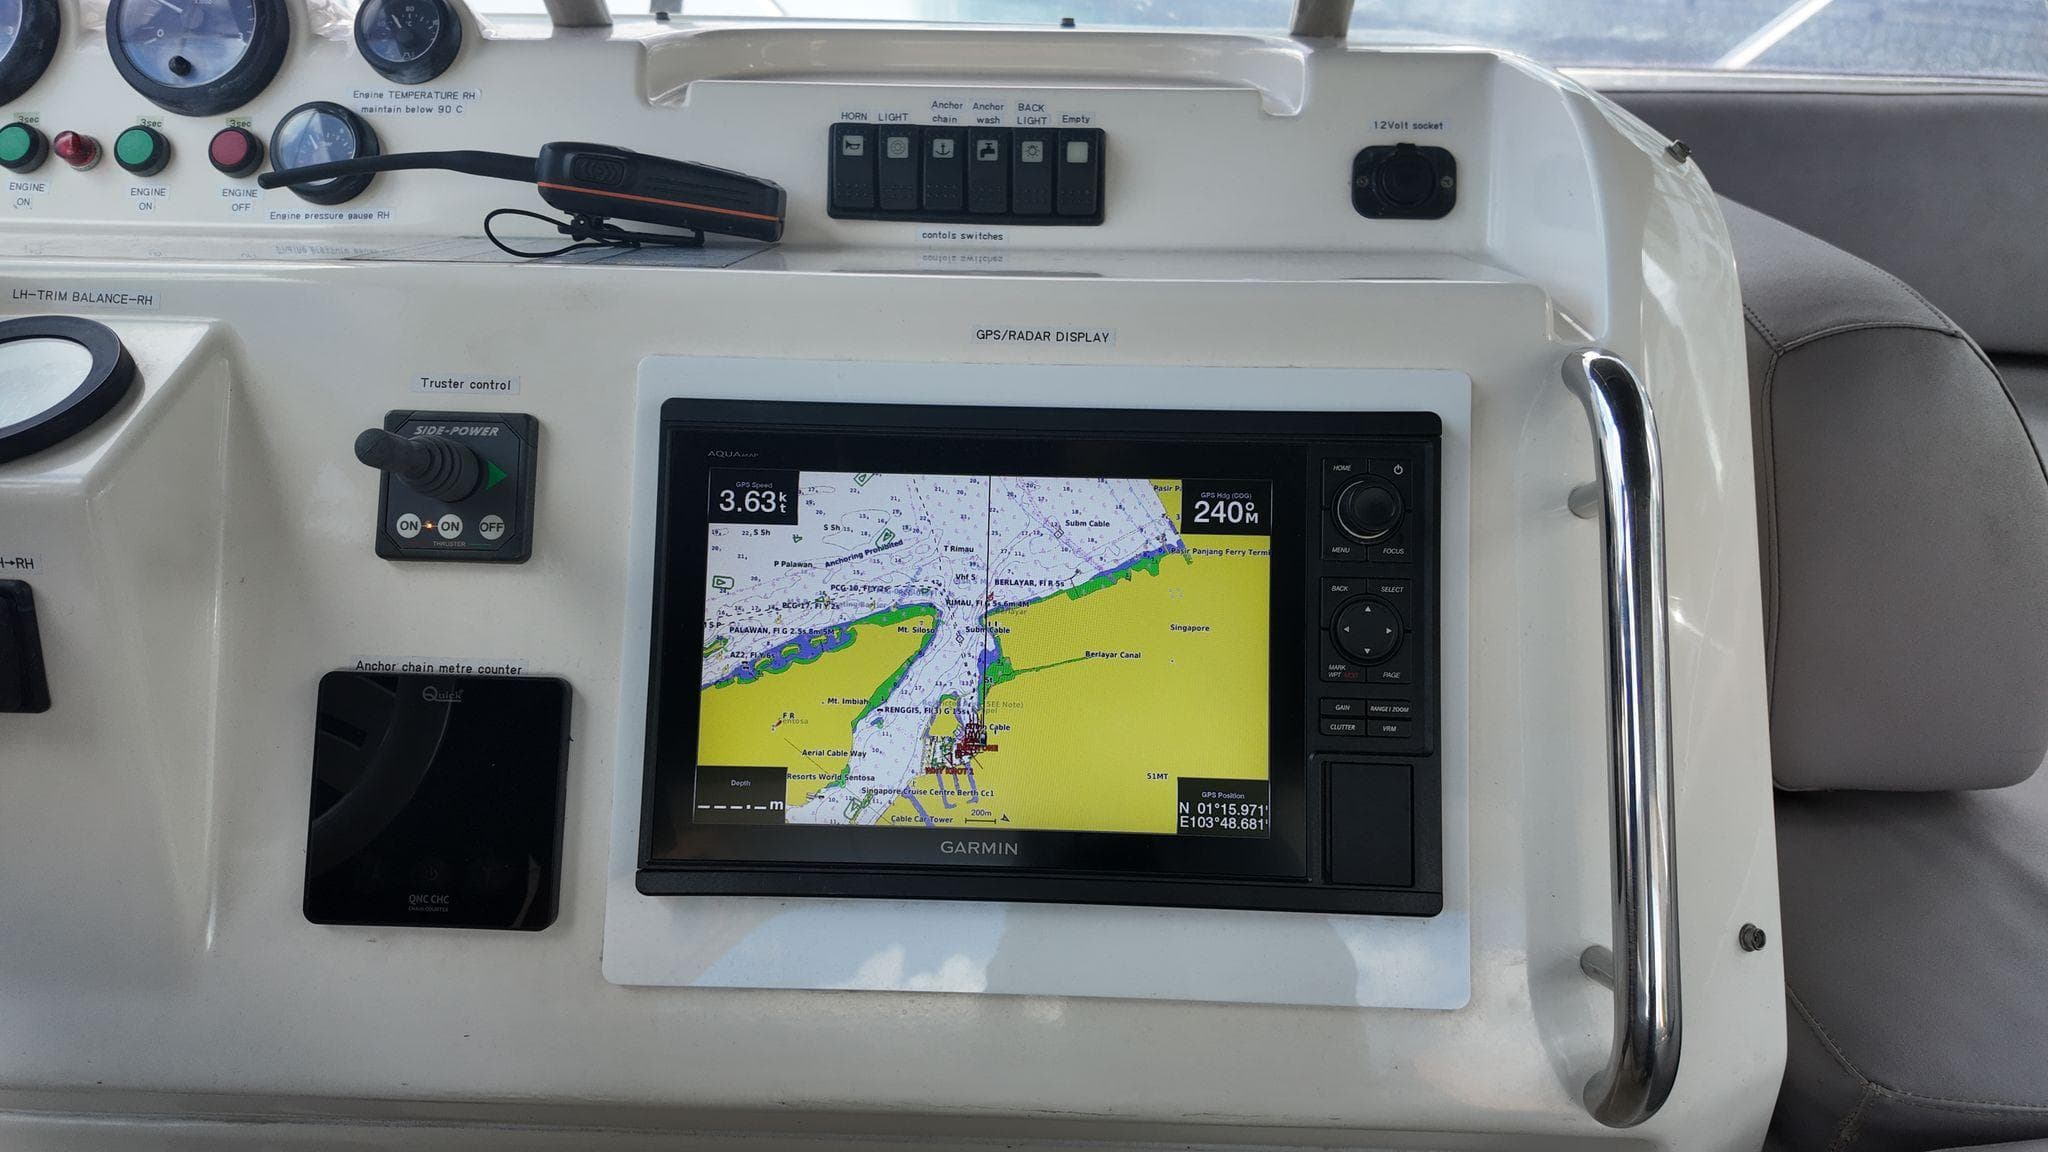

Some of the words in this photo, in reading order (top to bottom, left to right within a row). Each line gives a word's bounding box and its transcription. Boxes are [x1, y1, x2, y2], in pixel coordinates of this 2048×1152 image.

[353, 90, 383, 100] Engine
[388, 91, 459, 100] TEMPERATURE
[361, 105, 401, 113] maintain
[405, 105, 433, 114] below
[438, 105, 451, 113] 90
[931, 101, 963, 110] Anchor
[972, 103, 1004, 111] Anchor
[1018, 103, 1044, 112] BACK
[841, 112, 867, 121] HORN
[878, 113, 908, 121] LIGHT
[932, 115, 957, 123] chain
[977, 116, 1000, 124] wash
[1017, 117, 1047, 125] LIGHT
[1062, 115, 1090, 124] Empty
[1374, 121, 1408, 130] 12Volt
[1413, 121, 1443, 130] socket
[9, 182, 45, 192] ENGINE
[130, 188, 166, 196] ENGINE
[222, 188, 258, 198] ENGINE
[17, 198, 30, 206] ON
[139, 202, 152, 211] ON
[231, 203, 250, 212] OFF
[270, 211, 300, 220] Engine
[304, 212, 344, 220] pressure
[377, 211, 390, 219] RH
[922, 231, 956, 239] contols
[960, 232, 1003, 241] switches
[976, 329, 1051, 341] GPS/RADAR
[1056, 331, 1109, 342] DISPLAY
[420, 378, 464, 389] Truster
[470, 380, 511, 390] control
[414, 426, 500, 436] SIDE-POWER
[719, 490, 776, 512] 3.63
[400, 519, 418, 530] ON
[440, 519, 460, 531] ON
[480, 522, 503, 532] OFF
[1192, 548, 1223, 556] Panjang
[16, 557, 34, 569] RH
[825, 552, 864, 568] Anchoring
[1170, 625, 1210, 633] Singapore
[1085, 651, 1118, 659] Berlayar
[356, 660, 396, 672] Anchor
[401, 662, 434, 673] chain
[439, 663, 473, 674] metre
[478, 665, 522, 675] counter
[826, 749, 848, 757] Cable
[850, 750, 867, 758] Way
[731, 779, 751, 787] Depth
[861, 787, 901, 795] Singapore
[971, 808, 991, 816] 200m
[1179, 802, 1190, 814] N
[940, 841, 1018, 856] GARMIN
